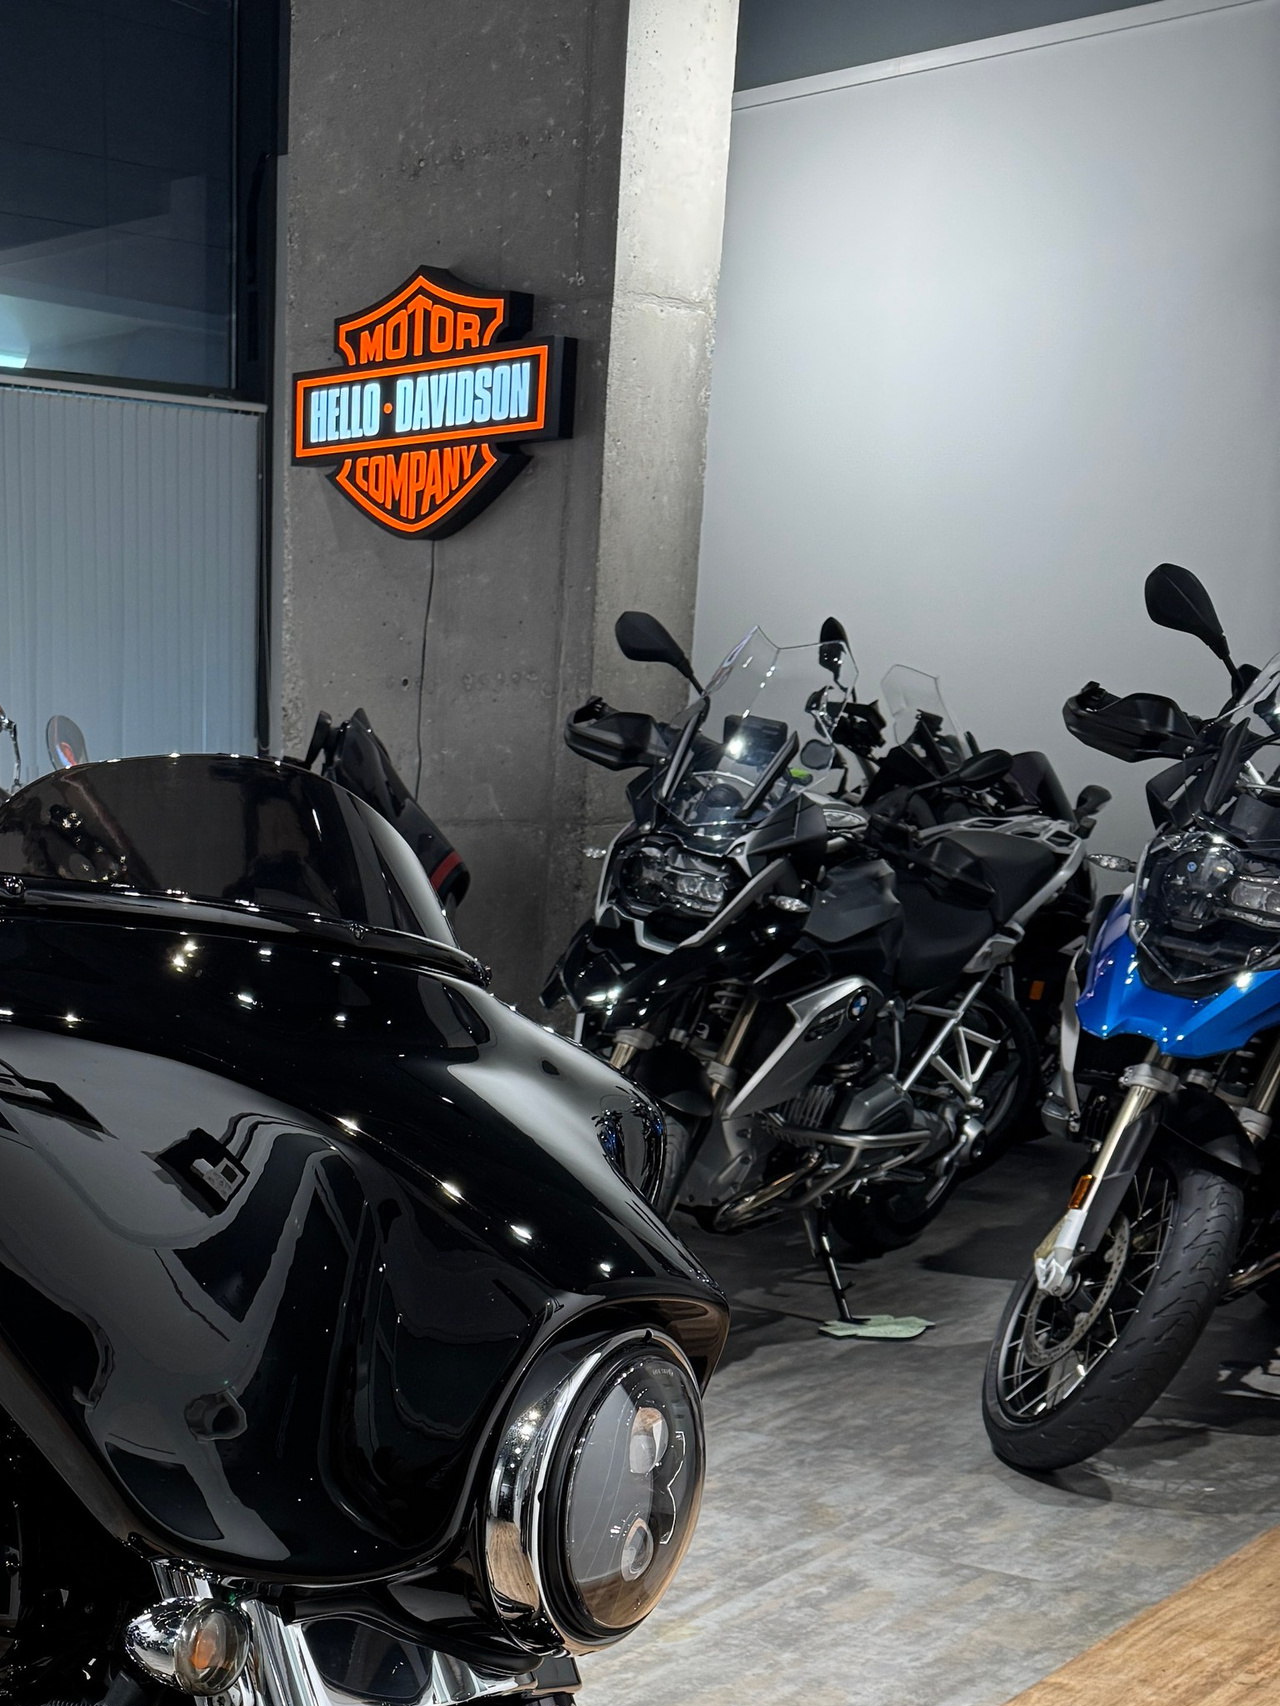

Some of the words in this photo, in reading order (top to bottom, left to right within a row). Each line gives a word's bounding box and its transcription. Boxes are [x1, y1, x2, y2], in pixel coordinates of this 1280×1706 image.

[359, 294, 481, 365] MOTOR
[310, 382, 381, 443] HELLO
[395, 361, 530, 433] DAVIDSON
[355, 444, 477, 519] COMPANY
